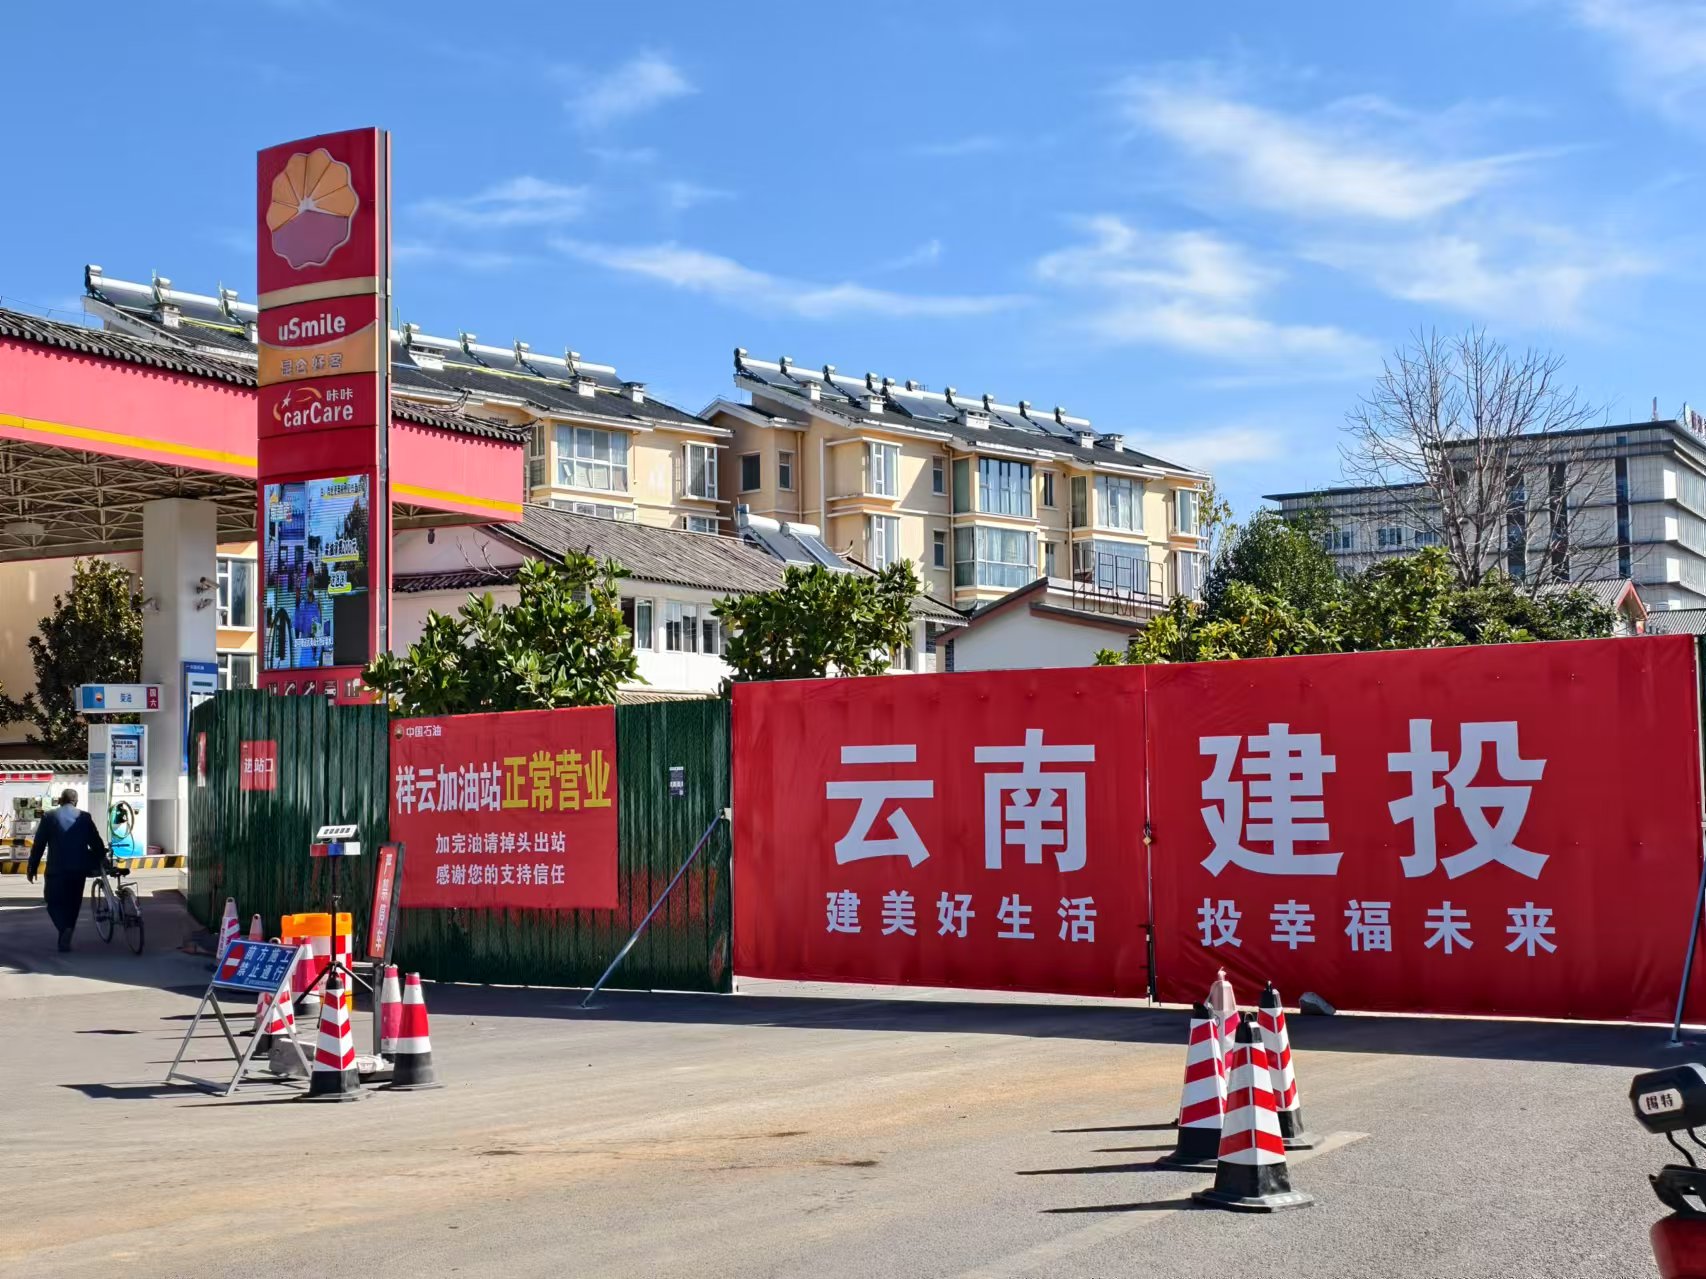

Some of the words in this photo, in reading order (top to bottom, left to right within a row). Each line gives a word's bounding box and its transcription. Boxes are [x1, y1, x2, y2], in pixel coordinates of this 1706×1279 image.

[278, 313, 346, 341] uSmile
[281, 352, 343, 376] 昆仑好客
[326, 387, 353, 402] 咔咔
[283, 401, 353, 428] carCare
[405, 724, 442, 738] 中国石油
[243, 757, 274, 773] 进站口
[395, 748, 612, 815] 祥云加油站正常营业
[435, 831, 566, 854] 加完油请掉头出站
[435, 863, 566, 886] 感谢您的支持信任
[825, 889, 1099, 943] 建美好生活
[1197, 897, 1558, 957] 投幸福未来
[244, 944, 293, 964] 前方施工
[236, 961, 285, 981] 禁止通行
